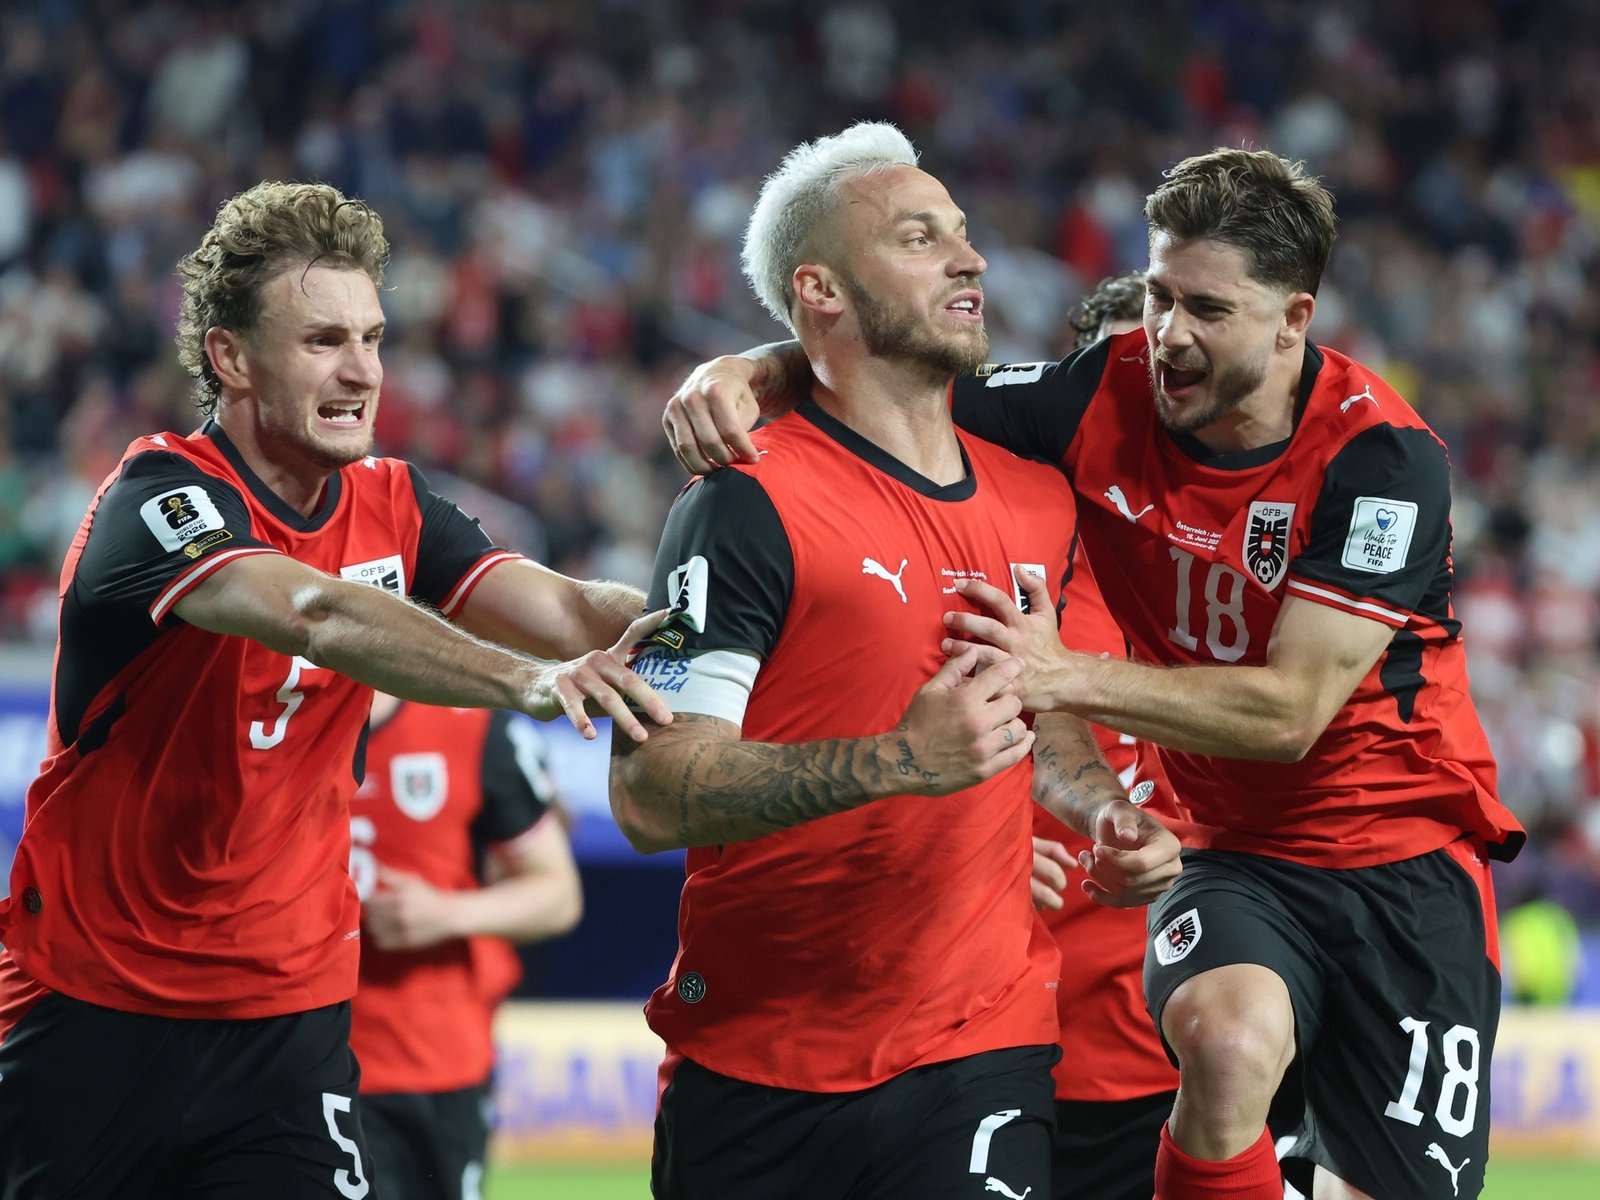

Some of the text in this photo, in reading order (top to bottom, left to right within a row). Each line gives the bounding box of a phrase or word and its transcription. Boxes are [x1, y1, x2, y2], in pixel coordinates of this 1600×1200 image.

[177, 515, 193, 525] FIFA
[175, 524, 193, 536] WORLD
[177, 523, 208, 541] 2026
[1363, 529, 1398, 546] Unite For
[196, 532, 225, 549] DEBUT
[1363, 542, 1393, 560] PEACE
[1367, 558, 1384, 567] FIFA
[1168, 545, 1250, 663] 18
[632, 656, 692, 676] NITES
[249, 655, 321, 750] 5
[1384, 1016, 1481, 1138] 18
[321, 1092, 370, 1200] 5
[968, 1108, 1022, 1174] 7
